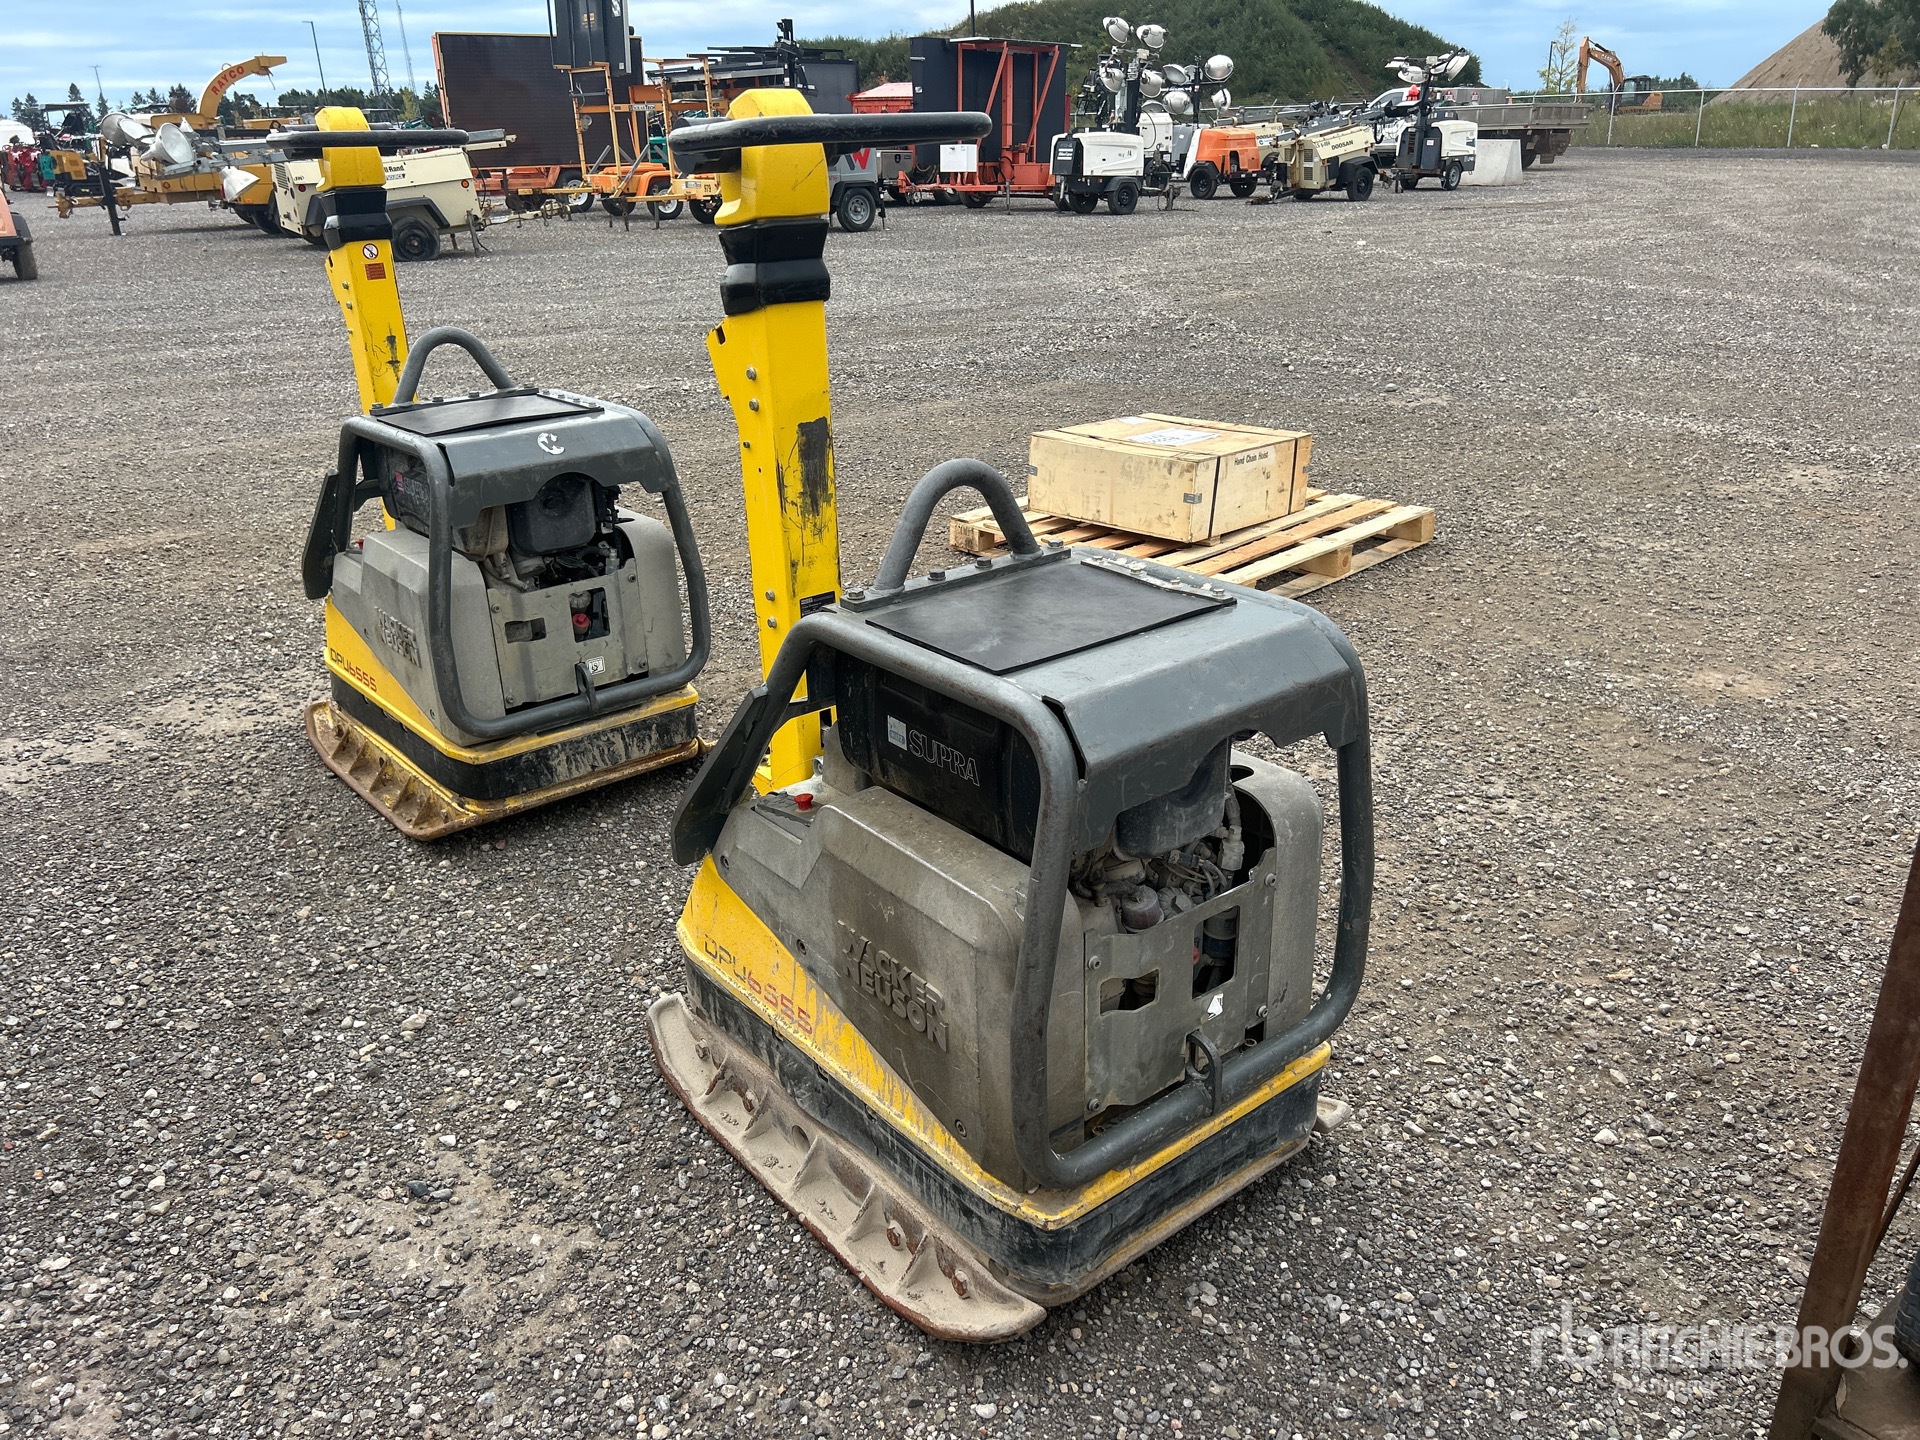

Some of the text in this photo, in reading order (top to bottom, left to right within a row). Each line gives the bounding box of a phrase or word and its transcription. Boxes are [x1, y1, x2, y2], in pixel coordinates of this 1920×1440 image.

[211, 65, 245, 95] RAYCO
[1331, 140, 1354, 150] DOOSAN
[1234, 456, 1245, 466] Hand
[1258, 451, 1269, 461] Hoist
[330, 647, 378, 692] DPU6555
[908, 729, 980, 787] SUPRA
[704, 933, 813, 1035] DPU6555
[837, 919, 946, 1016] WACKER
[841, 948, 950, 1054] NEUSON
